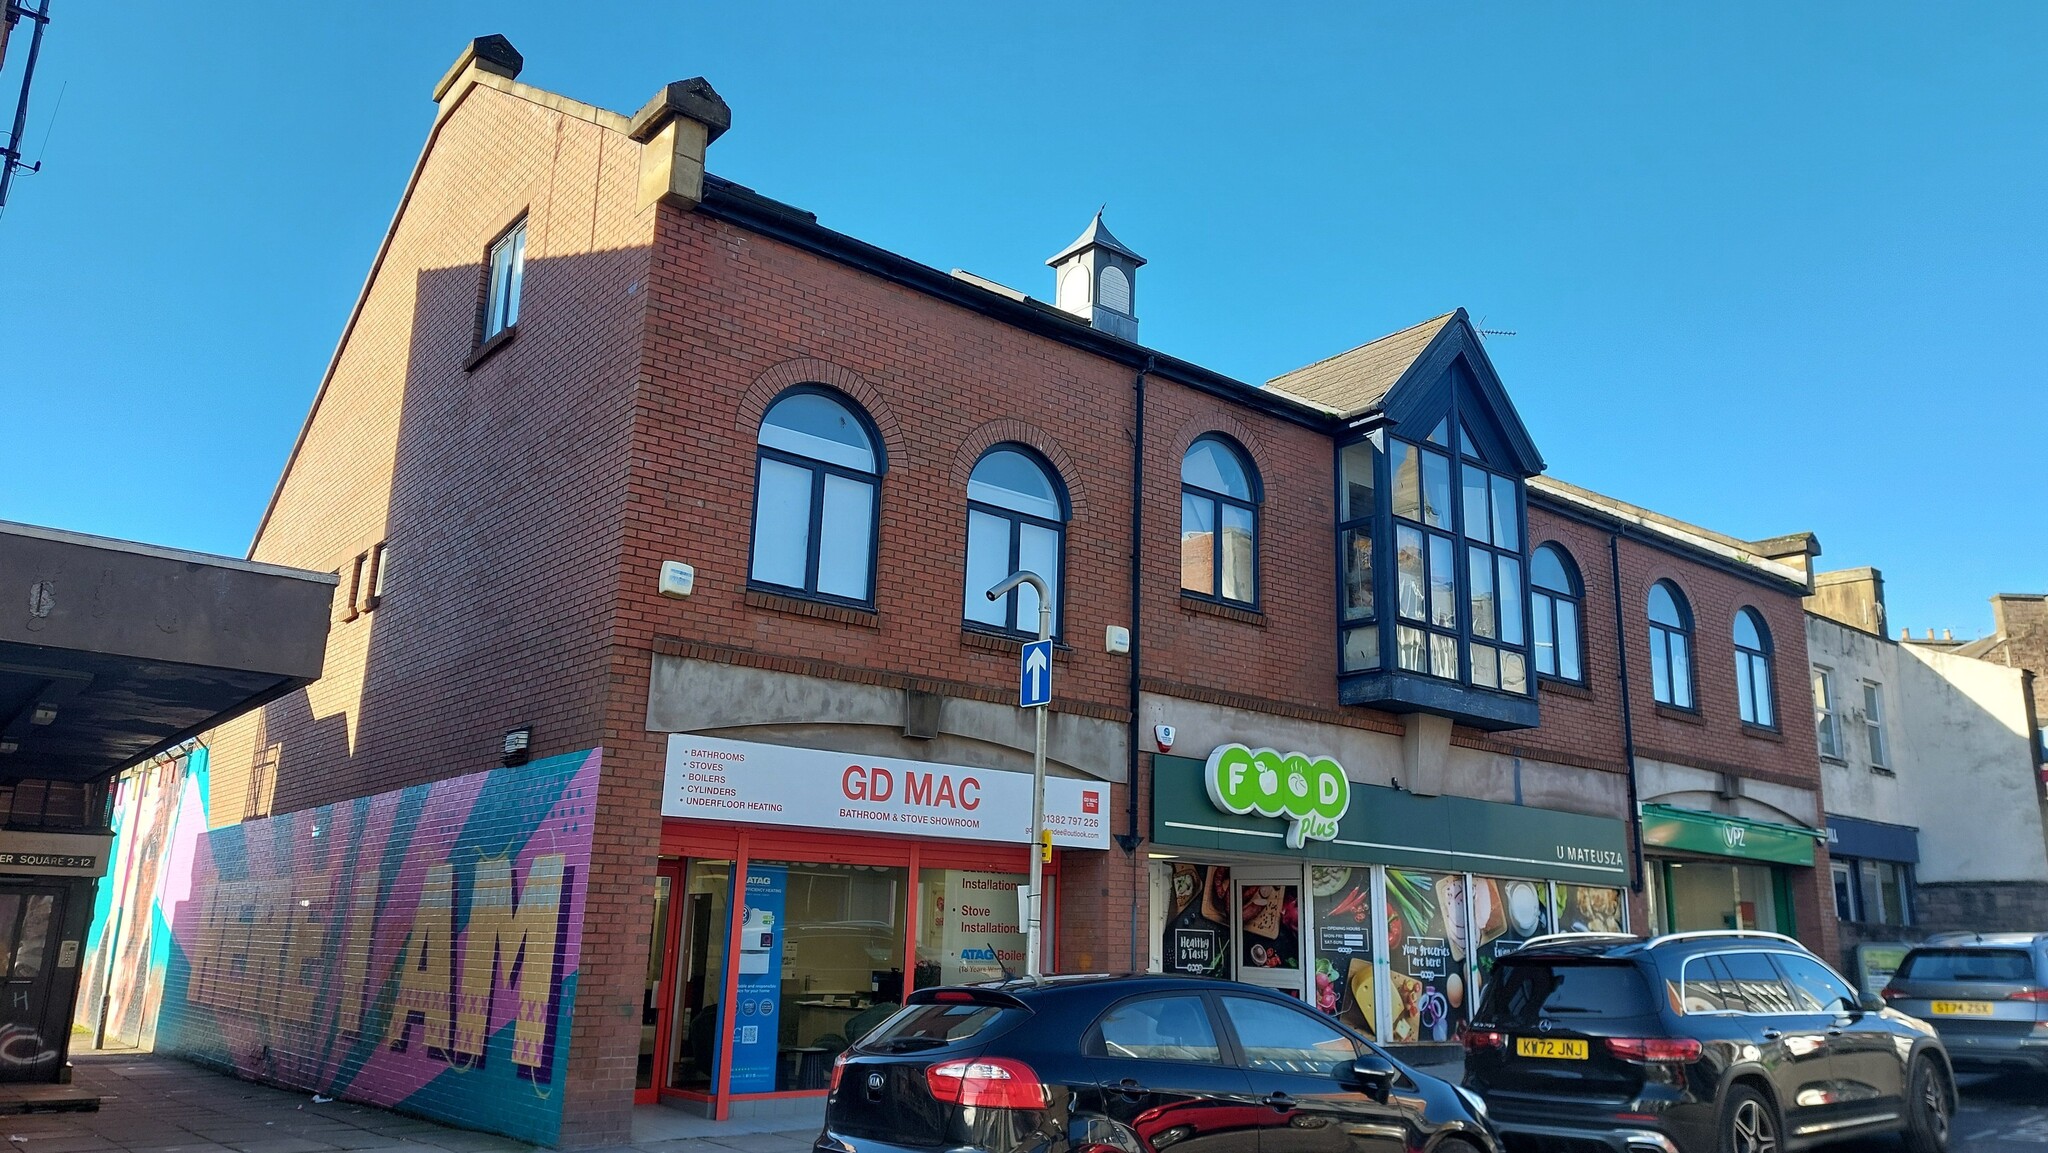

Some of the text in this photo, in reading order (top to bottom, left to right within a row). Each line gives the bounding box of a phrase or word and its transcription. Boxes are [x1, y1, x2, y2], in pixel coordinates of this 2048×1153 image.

[691, 749, 745, 761] BATHROOMS
[689, 761, 724, 771] STOVES
[688, 773, 726, 783] BOILERS
[687, 785, 737, 796] CYLINDERS
[842, 765, 981, 811] GD MAC
[686, 797, 783, 812] UNDERFLOOR HEATING
[839, 808, 980, 828] BATHROOM & STOVE SHOWROOM
[1068, 816, 1082, 826] 797
[1083, 818, 1099, 828] 226
[1299, 815, 1336, 846] plus
[1725, 826, 1746, 847] VPZ
[19, 855, 64, 866] SQUARE
[67, 858, 91, 867] 2-12
[1556, 845, 1624, 866] U MATEUSZA
[746, 876, 771, 885] ATAG
[962, 877, 1020, 891] Installation
[961, 904, 991, 917] Stove
[961, 921, 1020, 934] Installations
[1180, 936, 1210, 950] Healthy
[960, 949, 994, 960] ATAG
[1181, 948, 1209, 961] & Tasty
[1402, 944, 1450, 957] Your groceries
[1412, 957, 1425, 967] are
[1523, 1041, 1583, 1057] KW72 JNJ
